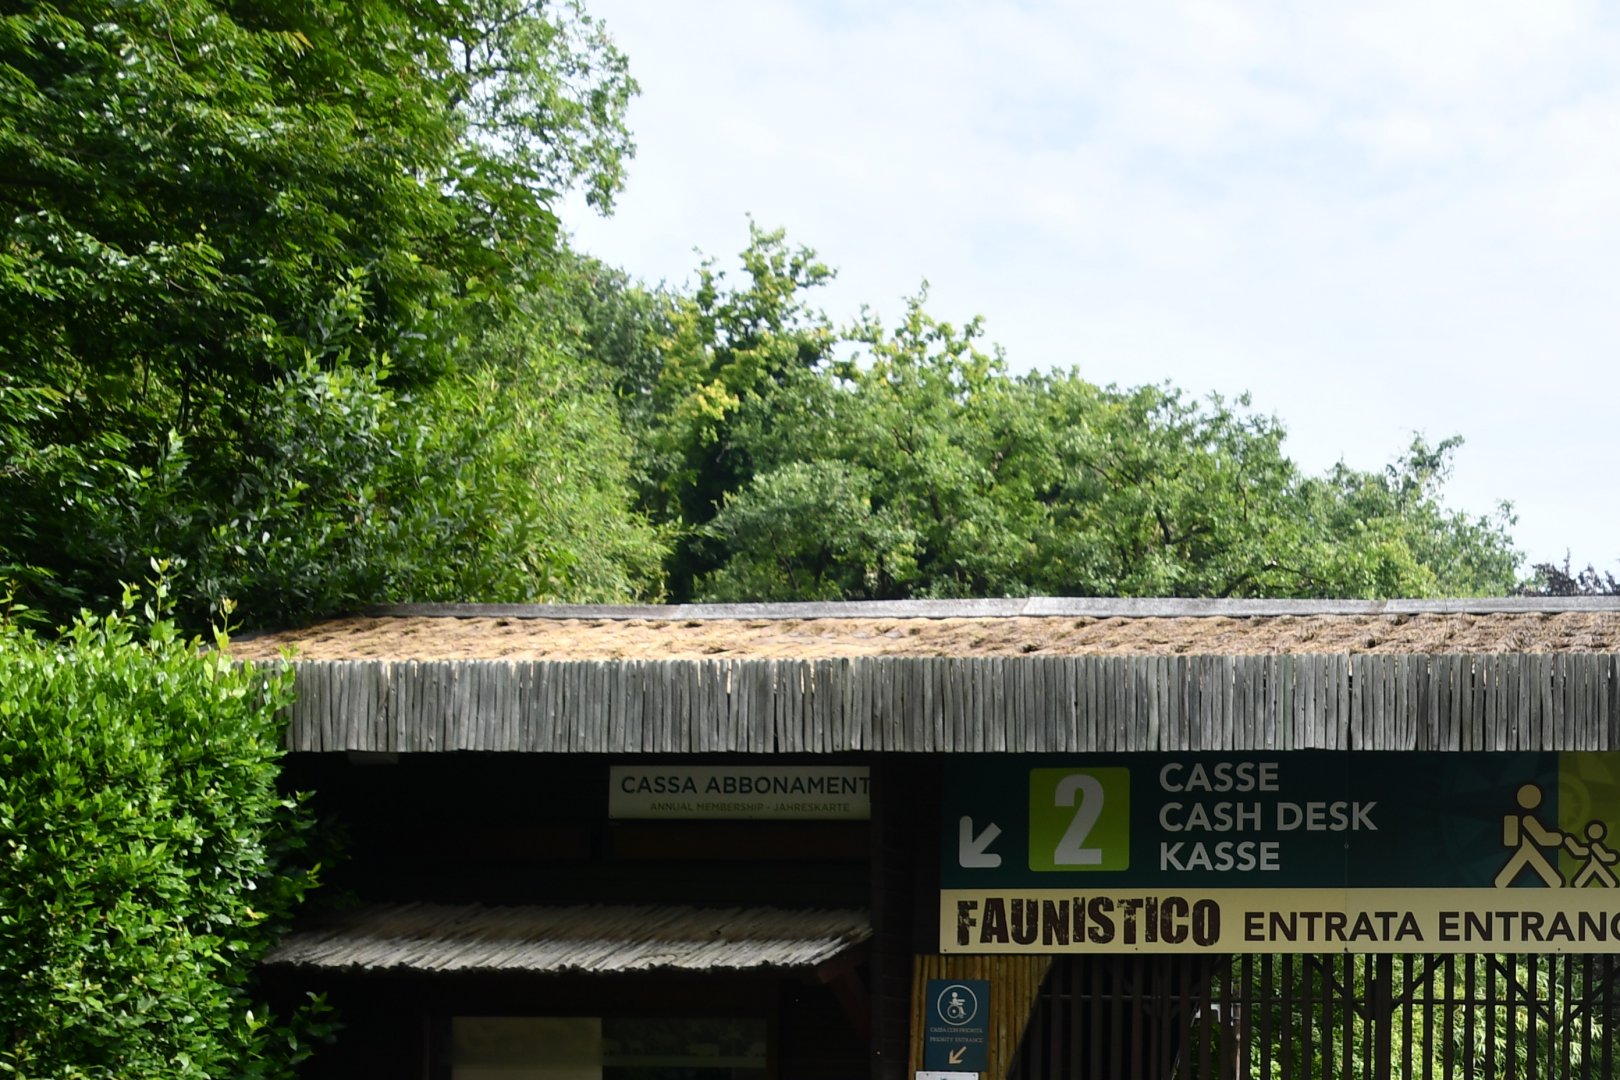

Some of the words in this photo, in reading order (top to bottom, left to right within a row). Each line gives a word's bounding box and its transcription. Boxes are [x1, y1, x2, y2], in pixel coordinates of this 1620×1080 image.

[621, 776, 697, 794] CASSA
[1160, 763, 1279, 792] CASSE
[650, 803, 693, 812] ANNUAL
[696, 803, 764, 812] MEMBERSHIP
[773, 803, 849, 813] JAHRESKARTE
[1053, 773, 1104, 866] 2
[1160, 802, 1262, 832] CASH
[1277, 802, 1379, 832] DESK
[1160, 842, 1279, 872] KASSE
[956, 896, 1220, 946] FAUNISTICO
[1244, 912, 1423, 942] ENTRATA
